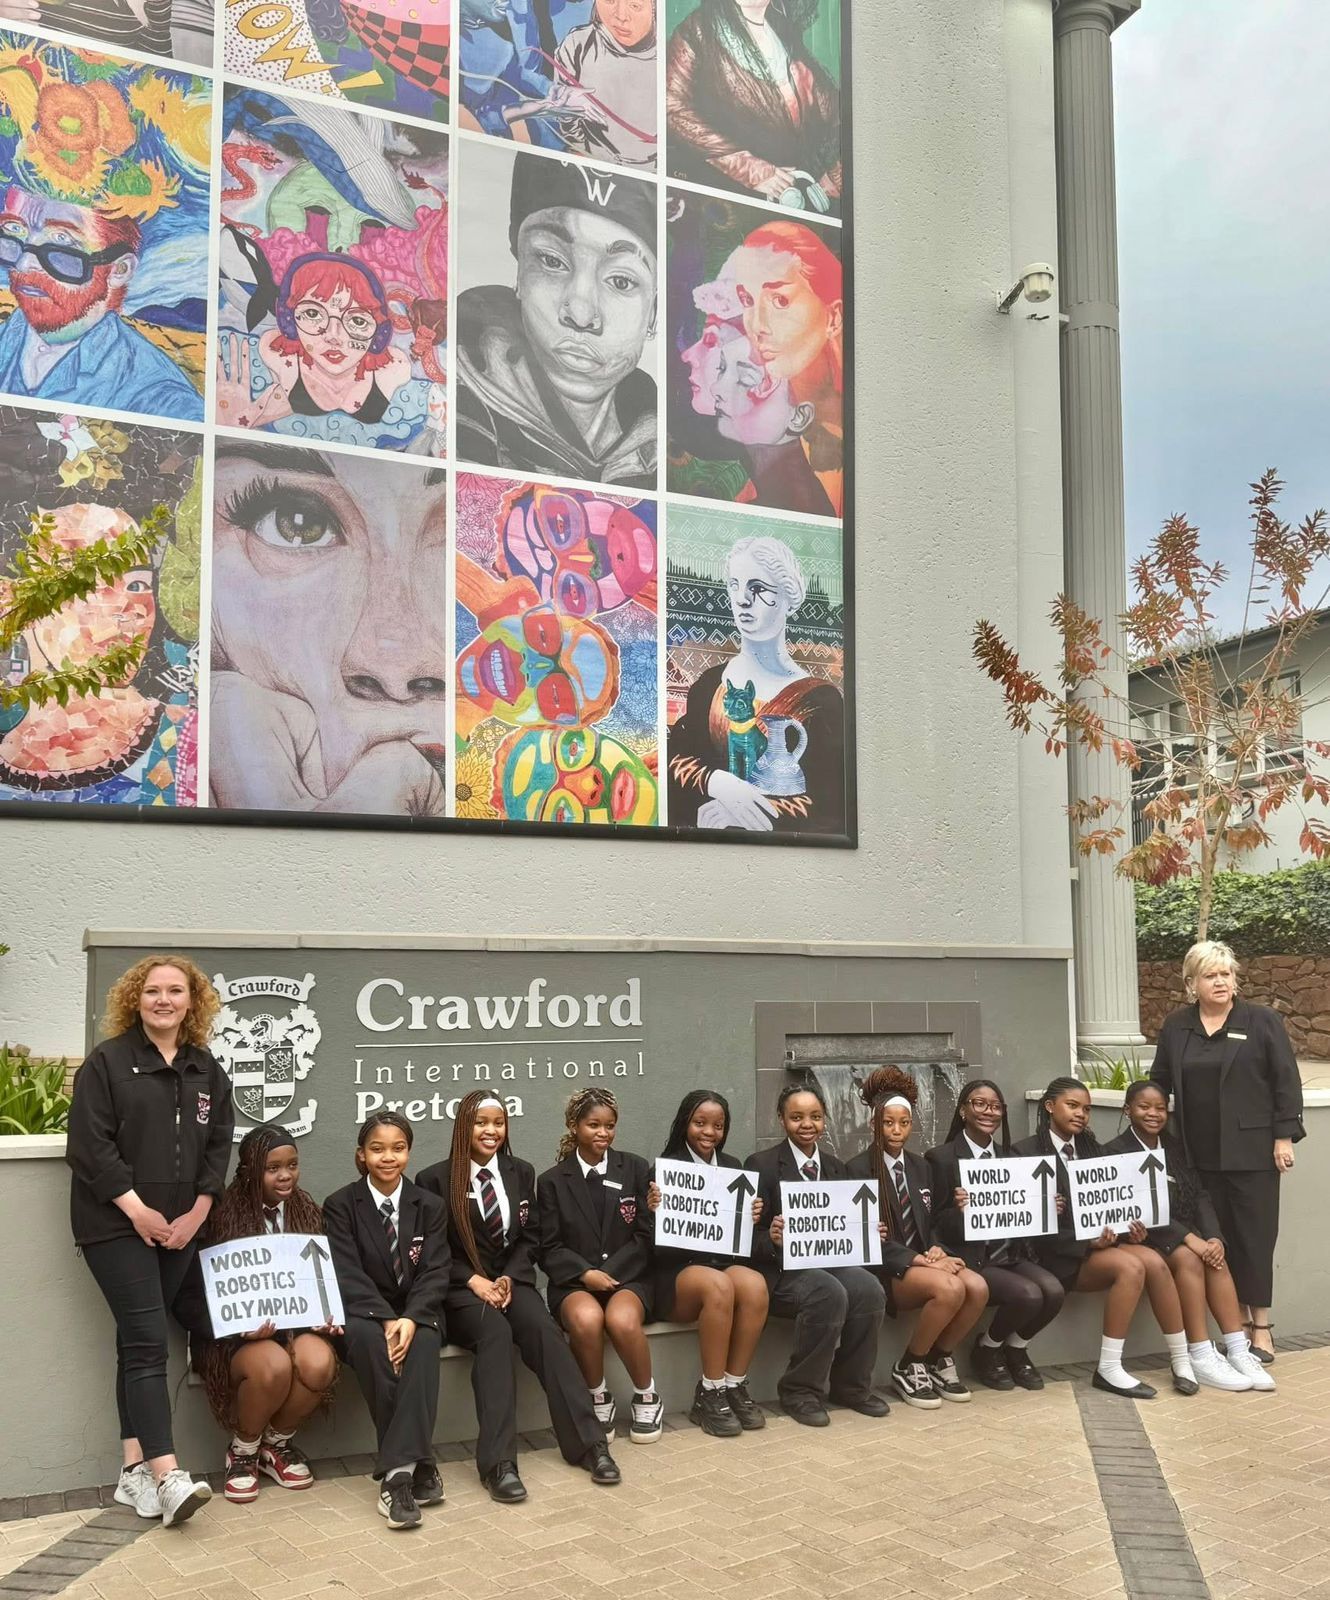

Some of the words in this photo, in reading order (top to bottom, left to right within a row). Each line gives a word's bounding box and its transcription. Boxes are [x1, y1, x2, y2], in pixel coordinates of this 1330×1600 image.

[226, 0, 385, 94] OW!
[227, 978, 301, 997] Crawford
[355, 977, 644, 1033] Crawford
[353, 1051, 646, 1085] International
[354, 1089, 525, 1125] Pretoa
[662, 1169, 706, 1192] WORLD
[967, 1168, 1011, 1185] WORLD
[1075, 1165, 1118, 1186] WORLD
[662, 1193, 720, 1218] ROBOTICS
[787, 1191, 831, 1210] WORLD
[968, 1189, 1027, 1208] ROBOTICS
[1077, 1185, 1135, 1207] ROBOTICS
[788, 1215, 847, 1235] ROBOTICS
[970, 1210, 1033, 1230] OLYMPIAD
[1080, 1205, 1142, 1229] OLYMPIAD
[662, 1216, 724, 1242] OLYMPIAD
[789, 1238, 854, 1258] OLYMPIAD
[210, 1247, 272, 1274] WORLD
[214, 1270, 296, 1298] ROBOTICS
[220, 1296, 309, 1322] OLYMPIAD
